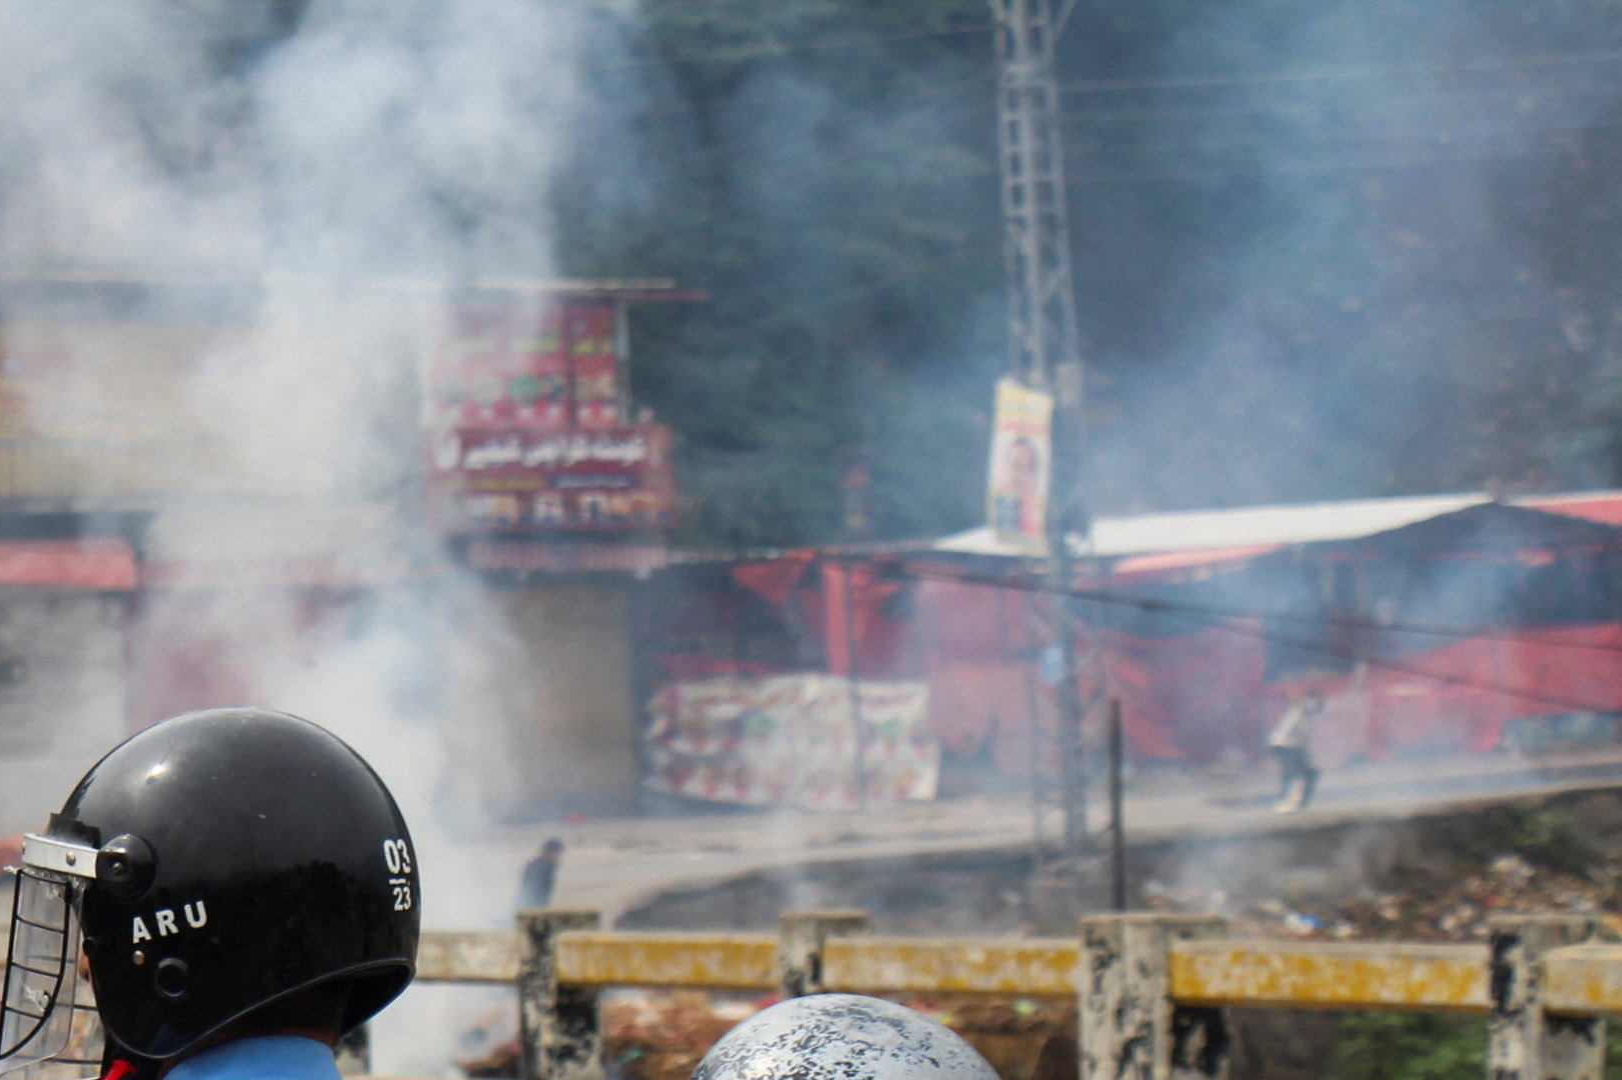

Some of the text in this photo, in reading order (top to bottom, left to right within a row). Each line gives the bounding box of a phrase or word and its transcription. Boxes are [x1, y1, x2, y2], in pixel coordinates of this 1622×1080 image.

[383, 839, 411, 874] 03
[393, 886, 412, 912] 23
[132, 901, 207, 944] ARU
